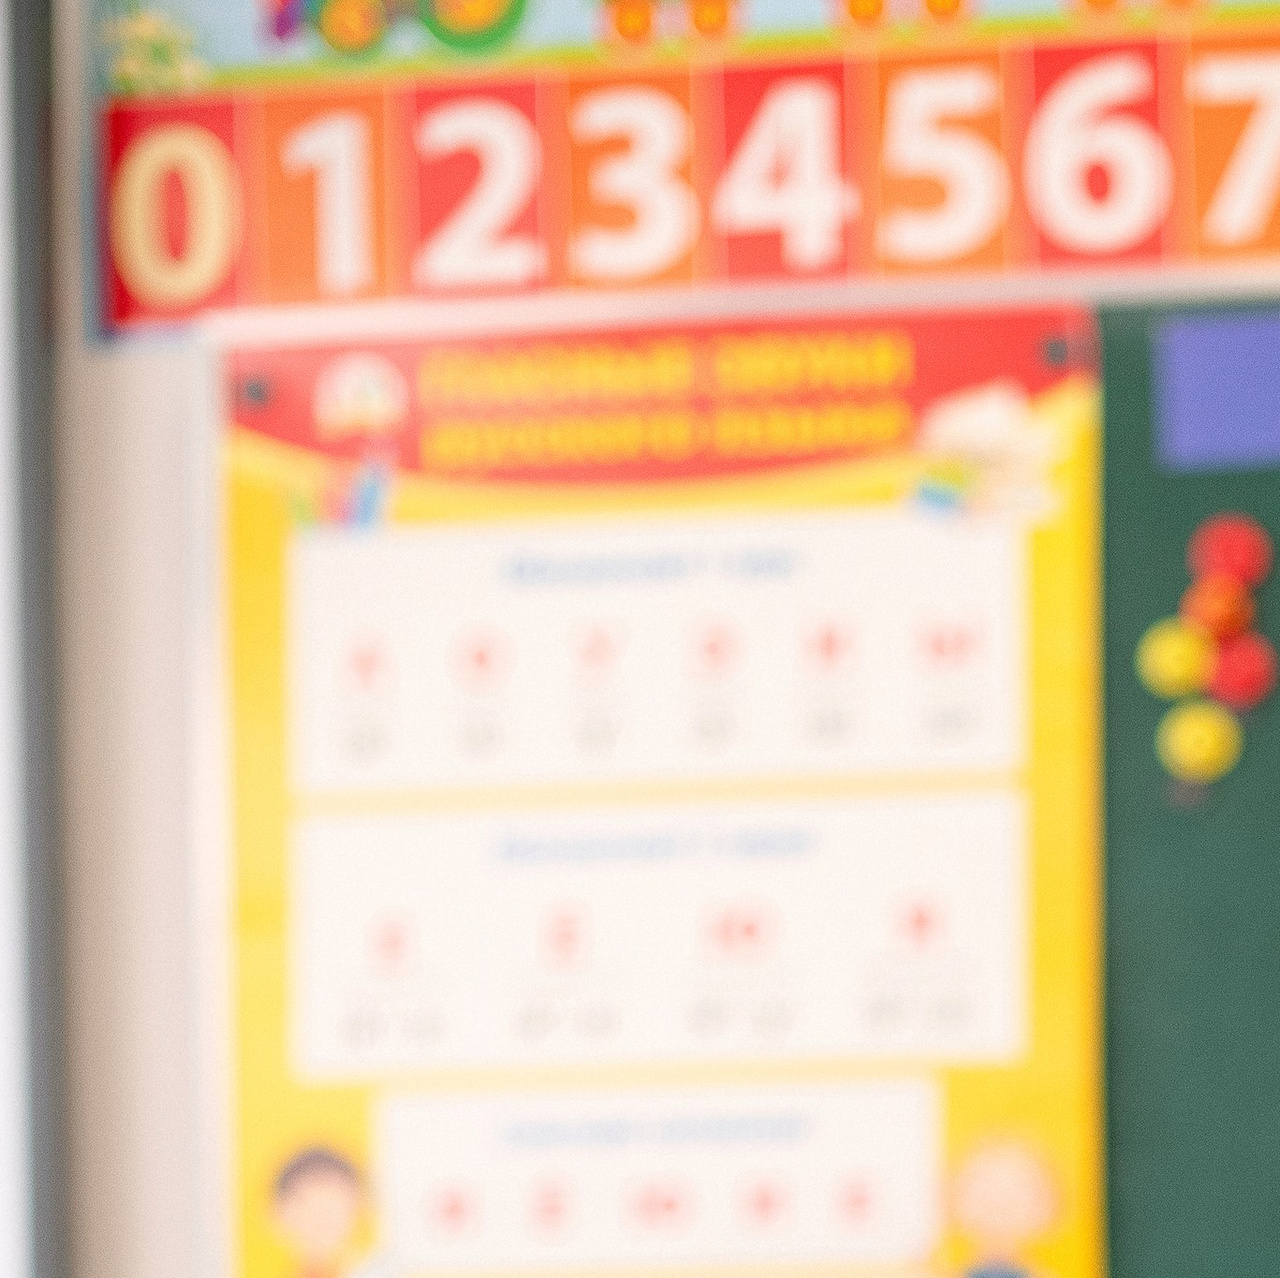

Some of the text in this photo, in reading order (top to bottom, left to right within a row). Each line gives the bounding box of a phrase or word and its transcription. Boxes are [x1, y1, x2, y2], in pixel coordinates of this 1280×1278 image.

[109, 124, 243, 309] 0
[280, 111, 376, 298] 1
[414, 98, 549, 292] 2
[566, 86, 701, 279] 3
[708, 76, 860, 272] 4
[876, 66, 1008, 261] 5
[1023, 53, 1173, 252] 6
